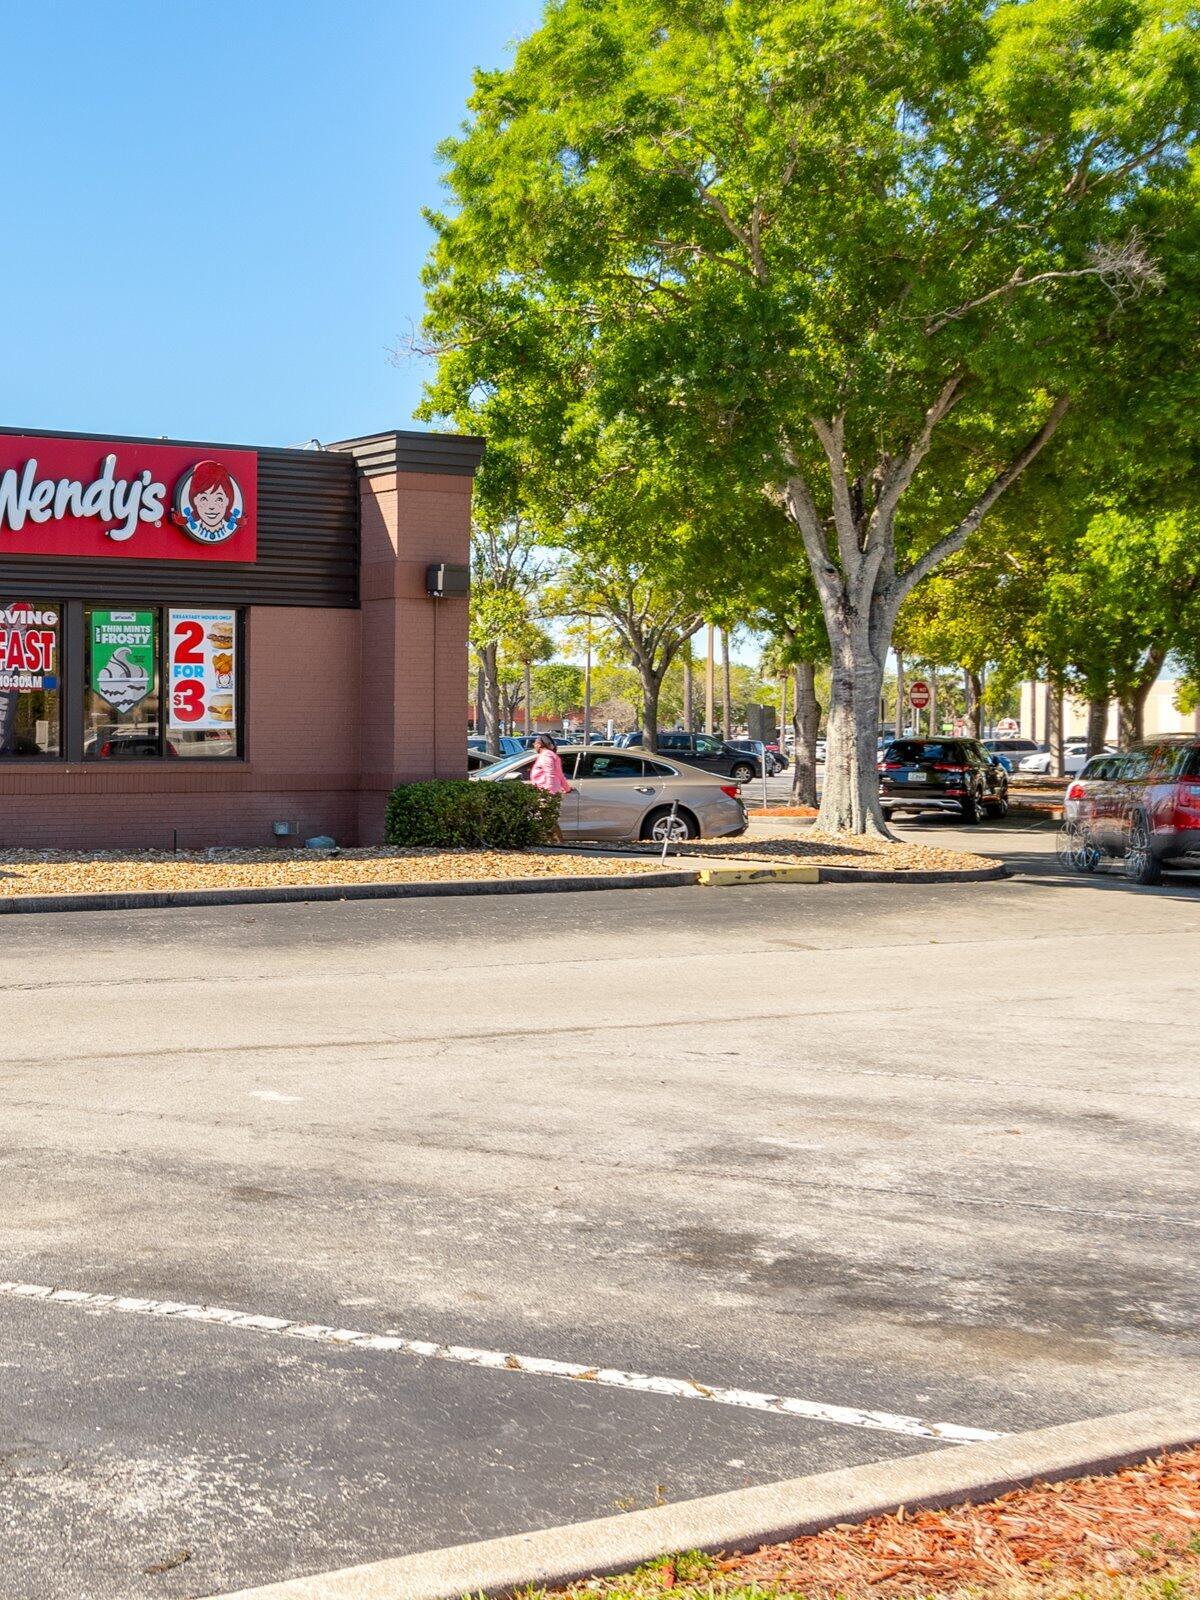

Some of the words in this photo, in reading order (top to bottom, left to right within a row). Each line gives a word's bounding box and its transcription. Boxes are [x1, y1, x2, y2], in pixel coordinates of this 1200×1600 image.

[101, 625, 122, 633] THIN
[123, 625, 151, 633] MINTS
[101, 633, 151, 644] FROSTY
[174, 621, 204, 664] 2
[173, 665, 204, 678] FOR
